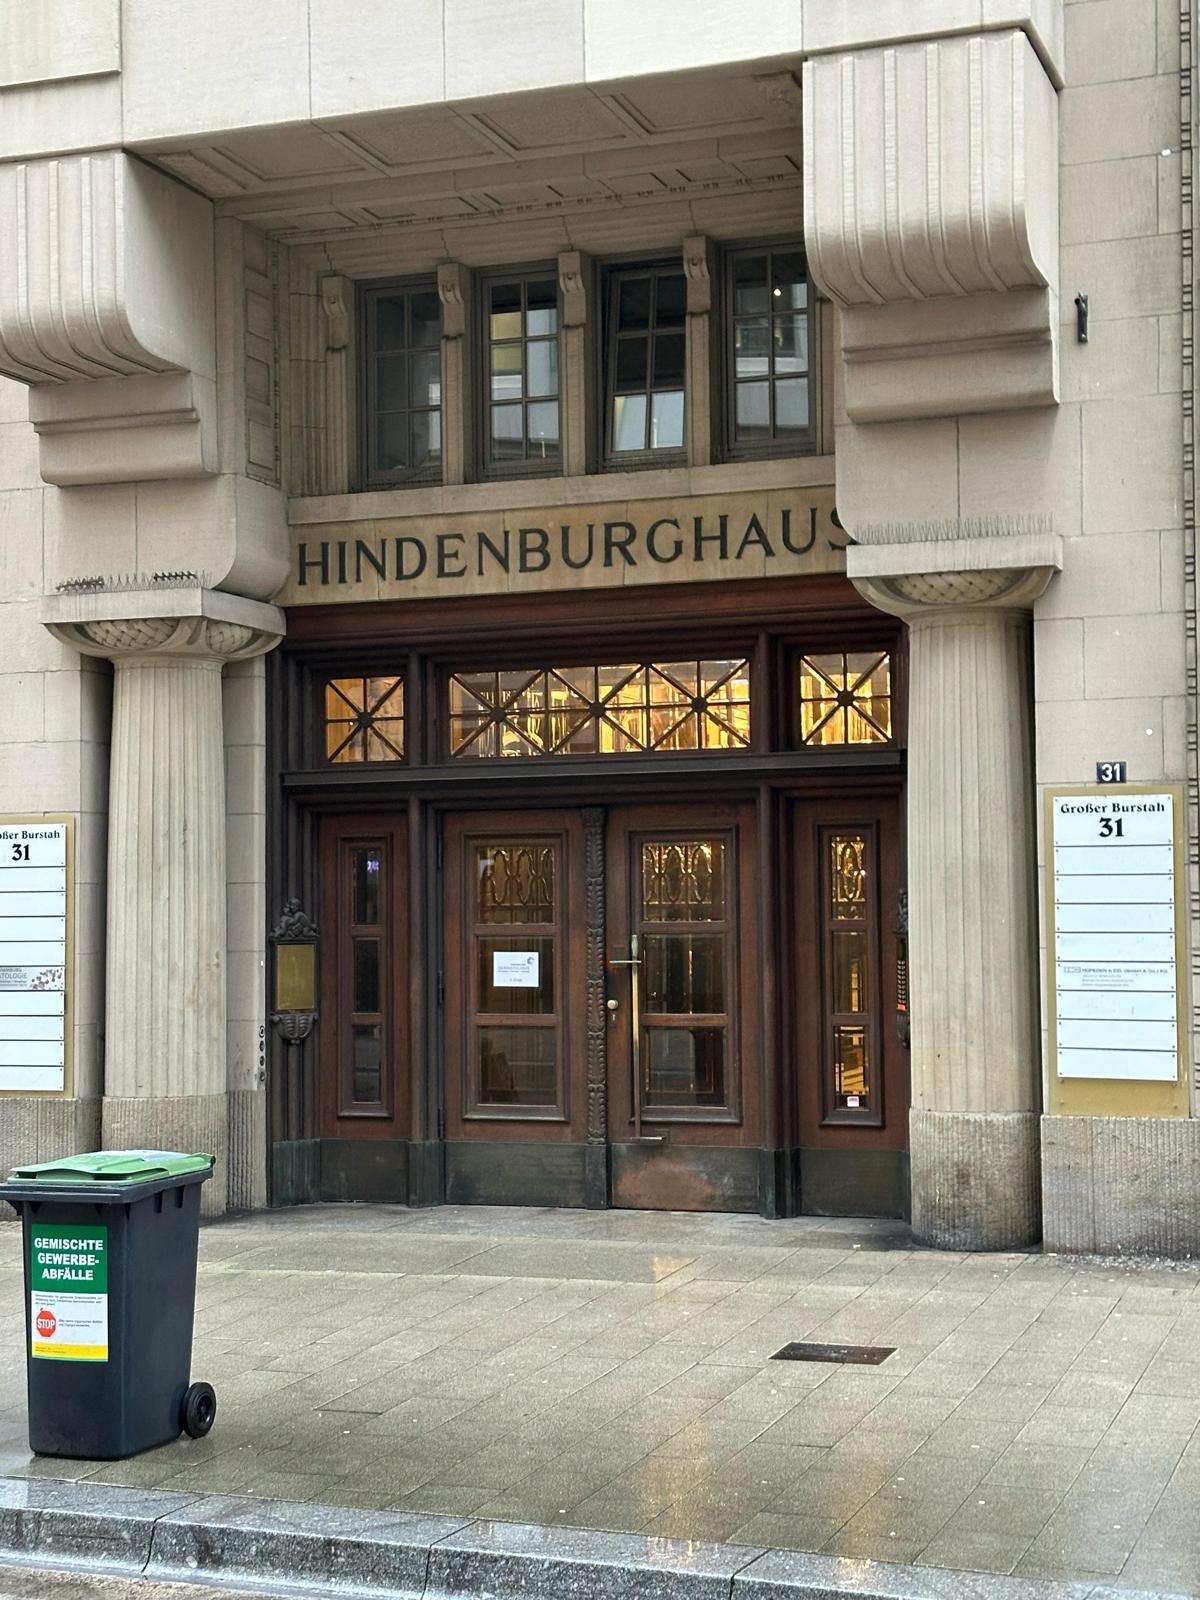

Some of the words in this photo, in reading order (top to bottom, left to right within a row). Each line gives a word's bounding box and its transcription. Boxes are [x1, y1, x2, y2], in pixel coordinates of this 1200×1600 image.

[1101, 763, 1121, 782] 31
[1060, 802, 1108, 814] Großer
[1112, 802, 1165, 813] Burstah
[1099, 816, 1124, 837] 31
[21, 829, 60, 839] Burstah
[11, 843, 30, 861] 31
[34, 1237, 104, 1251] GEMISCHTE
[37, 1252, 100, 1266] GEWERBE-
[41, 1267, 94, 1281] ABFÄLLE
[37, 1318, 56, 1329] STOP
